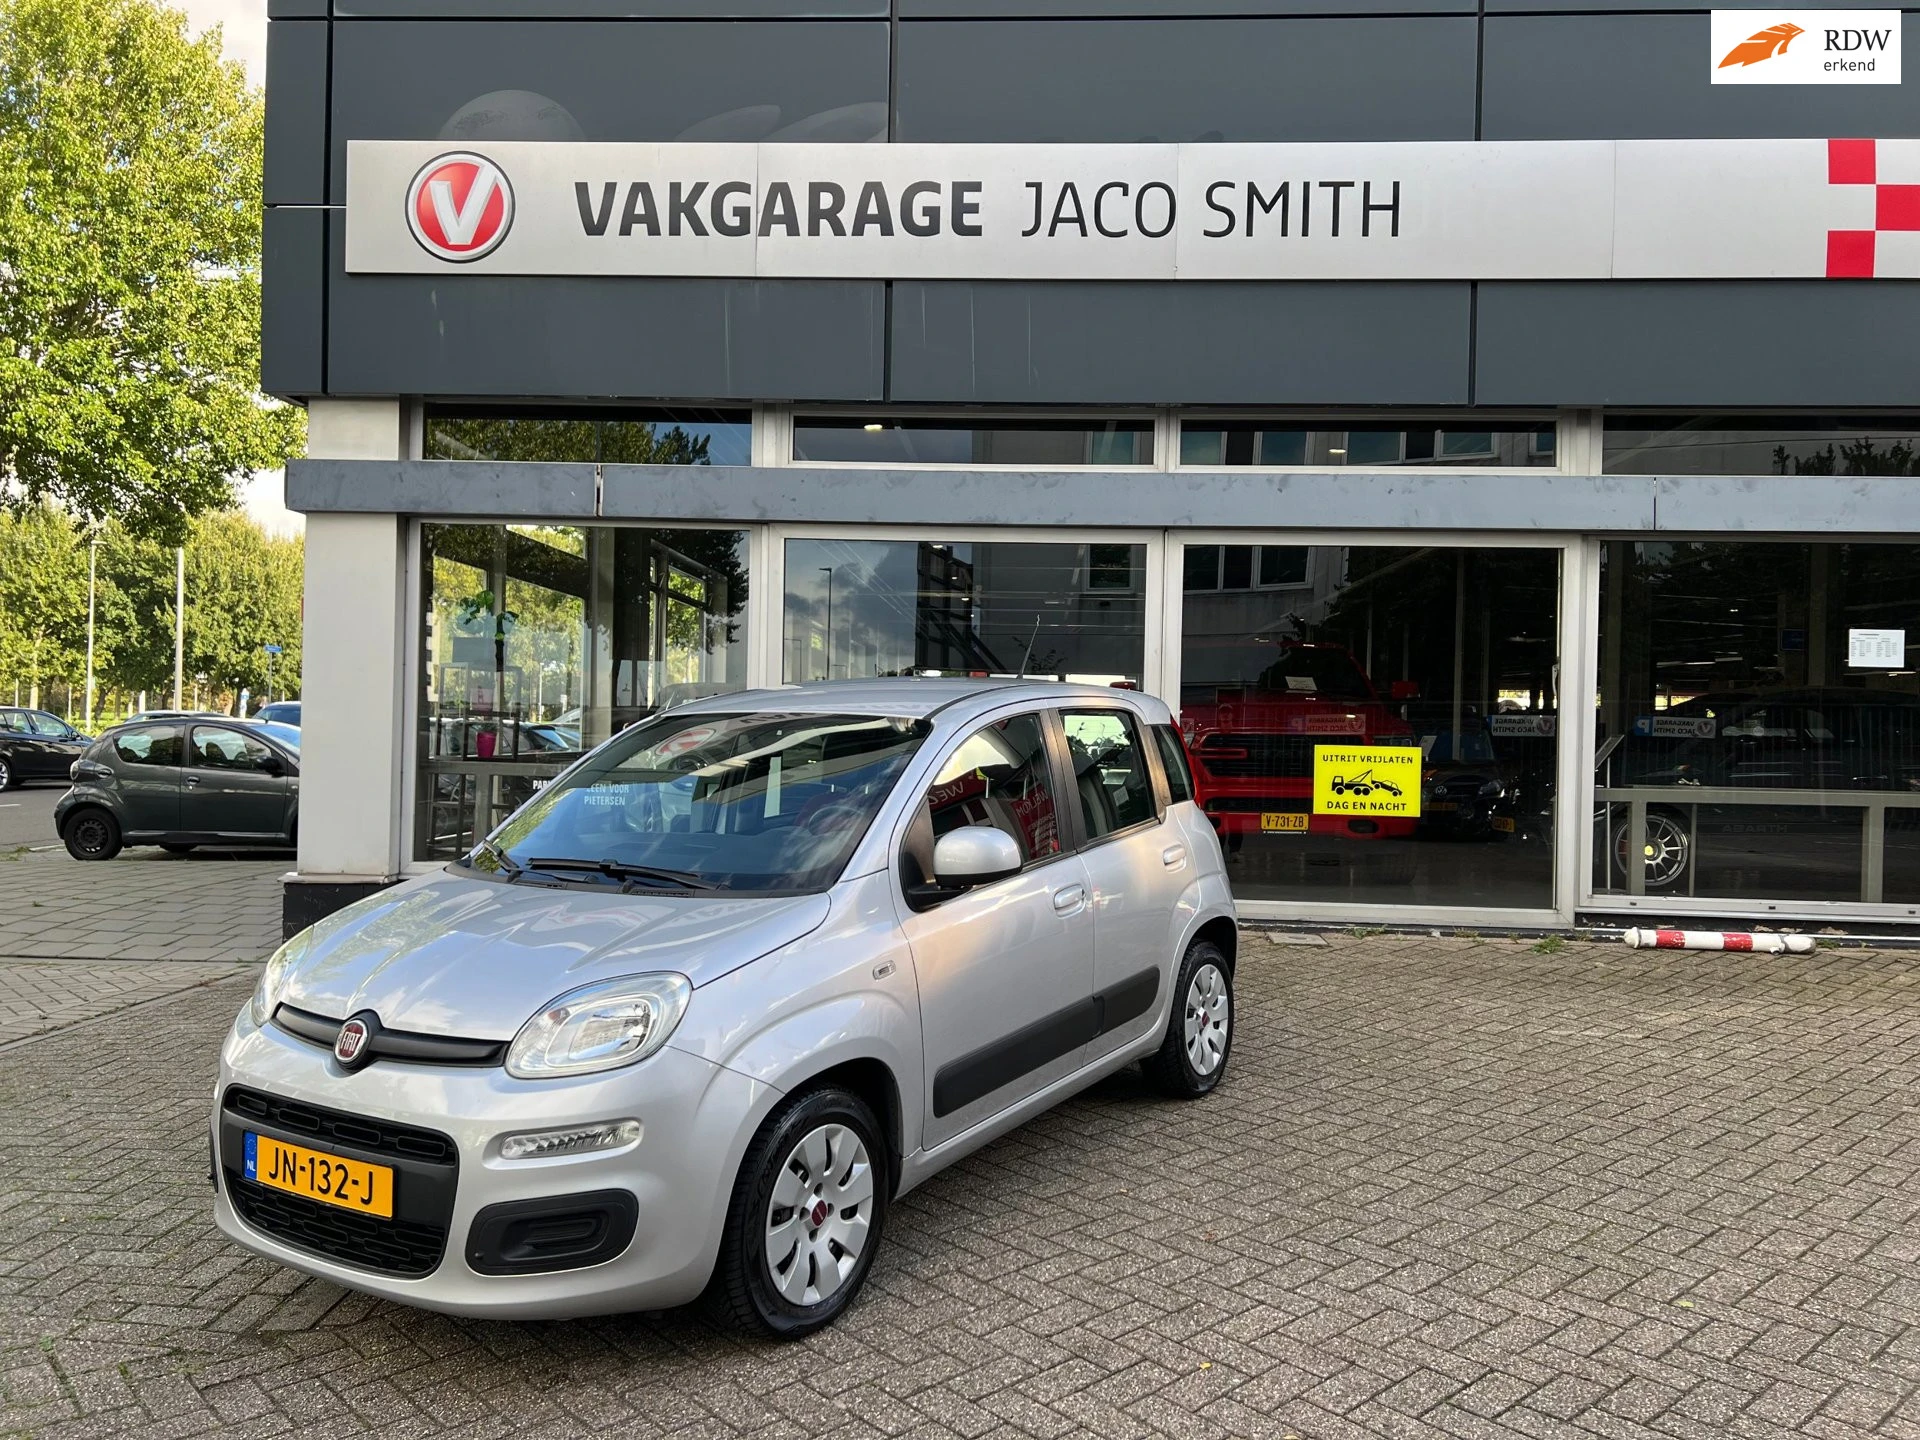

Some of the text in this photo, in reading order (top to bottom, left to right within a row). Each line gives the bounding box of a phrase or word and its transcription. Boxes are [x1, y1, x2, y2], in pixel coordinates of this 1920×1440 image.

[574, 180, 1401, 238] VAKGARAGE JACO SMITH
[1322, 754, 1413, 764] UITRIT VRIJLATEN
[609, 784, 629, 793] VOOR
[584, 796, 626, 806] PIETERSEN
[1327, 801, 1407, 811] DAG EN NACHT
[1265, 815, 1304, 828] V-731-ZB
[340, 1031, 362, 1052] FIAT
[246, 1159, 257, 1172] NL
[268, 1147, 374, 1206] JN-132-J
